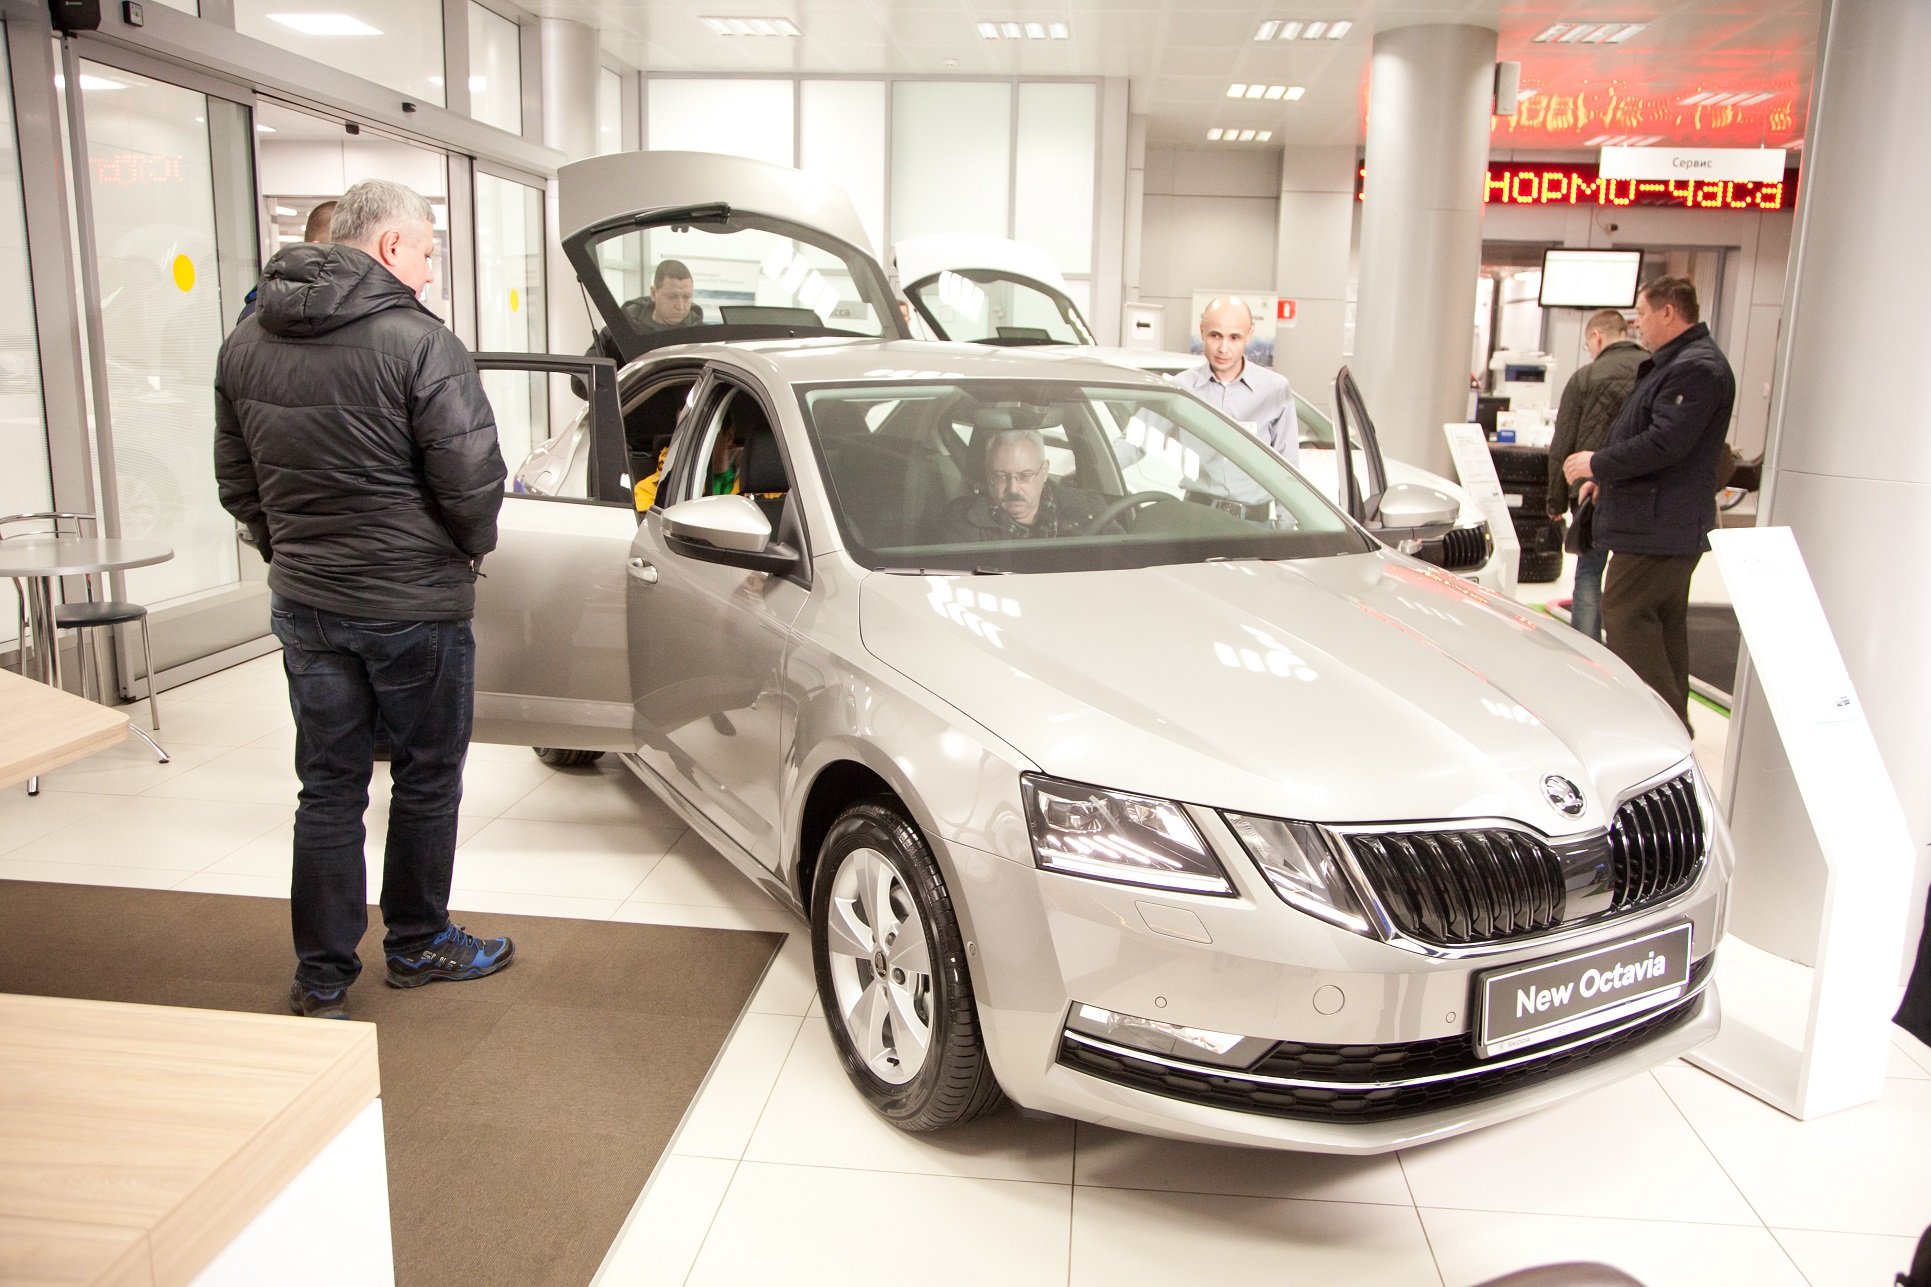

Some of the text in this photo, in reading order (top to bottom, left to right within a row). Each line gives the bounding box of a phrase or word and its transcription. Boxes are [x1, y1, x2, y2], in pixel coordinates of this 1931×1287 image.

[1672, 156, 1713, 171] Сервис
[1516, 952, 1666, 1018] New Octavia
